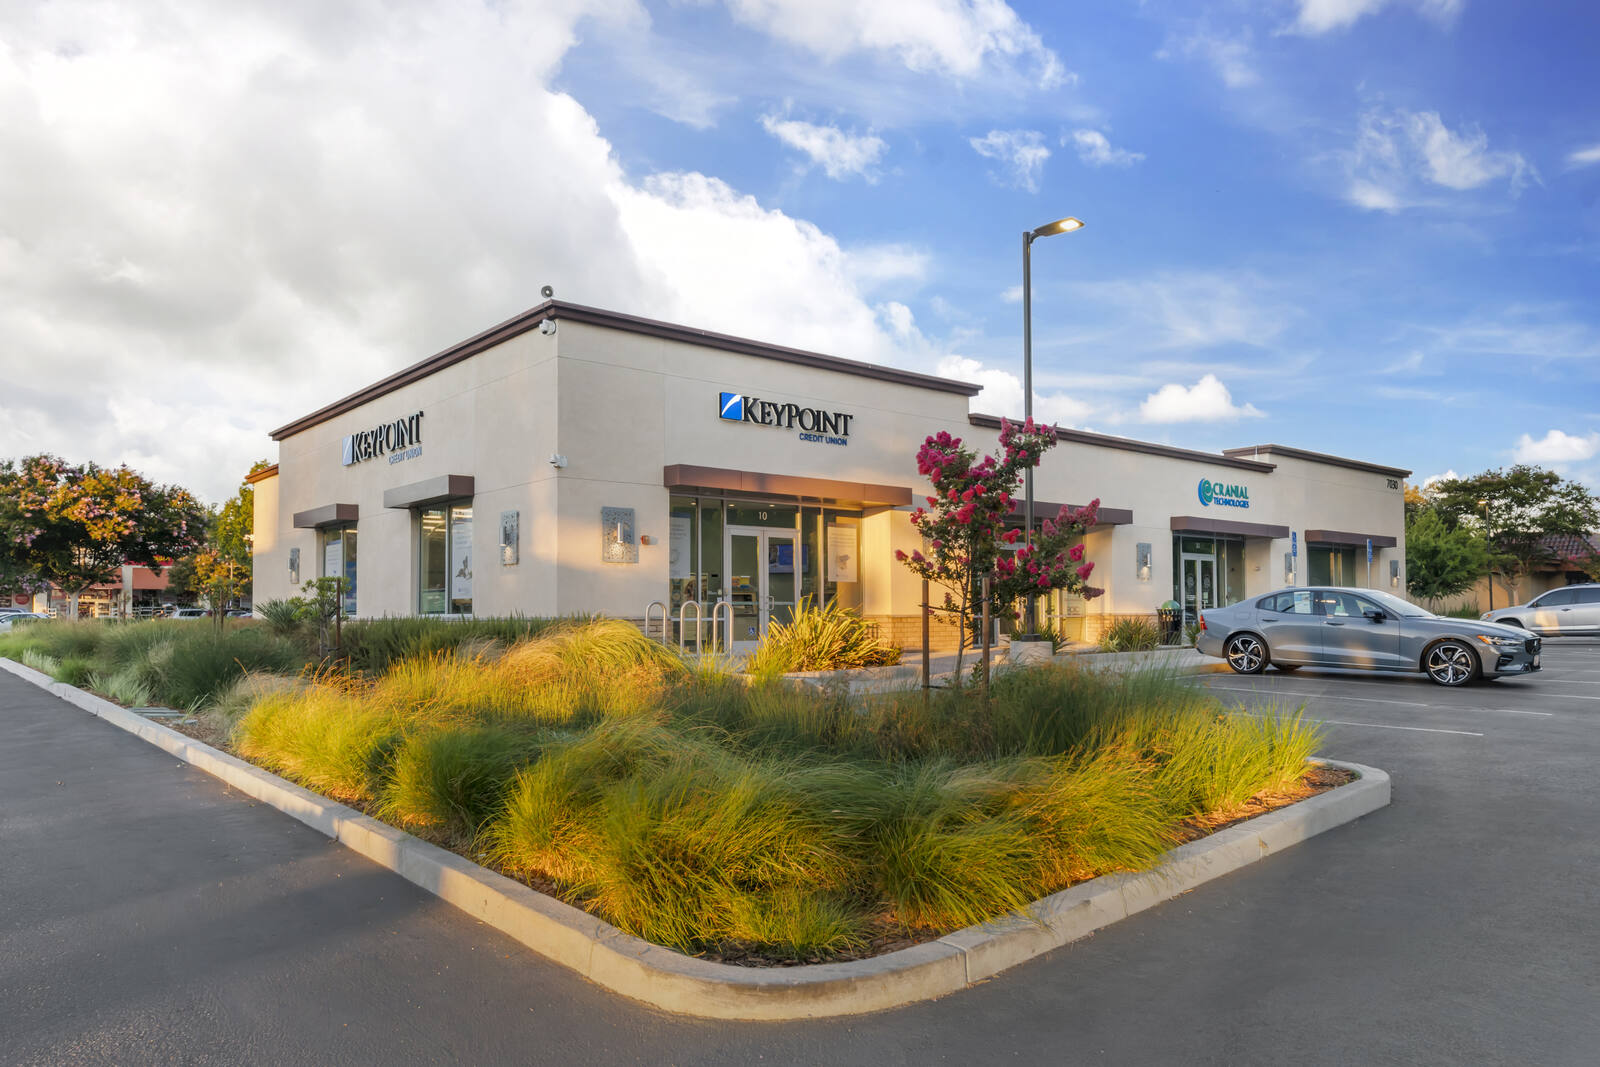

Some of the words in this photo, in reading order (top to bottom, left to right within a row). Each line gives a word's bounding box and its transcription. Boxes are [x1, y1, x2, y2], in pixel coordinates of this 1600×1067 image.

[742, 396, 853, 436] KEYPOINT
[352, 410, 424, 464] KEYPOINT
[799, 433, 824, 444] CREDIT
[825, 436, 847, 446] UNION
[1213, 482, 1249, 499] CRANIAL
[1213, 497, 1249, 508] TECHNOLOGIES
[758, 511, 768, 521] 10
